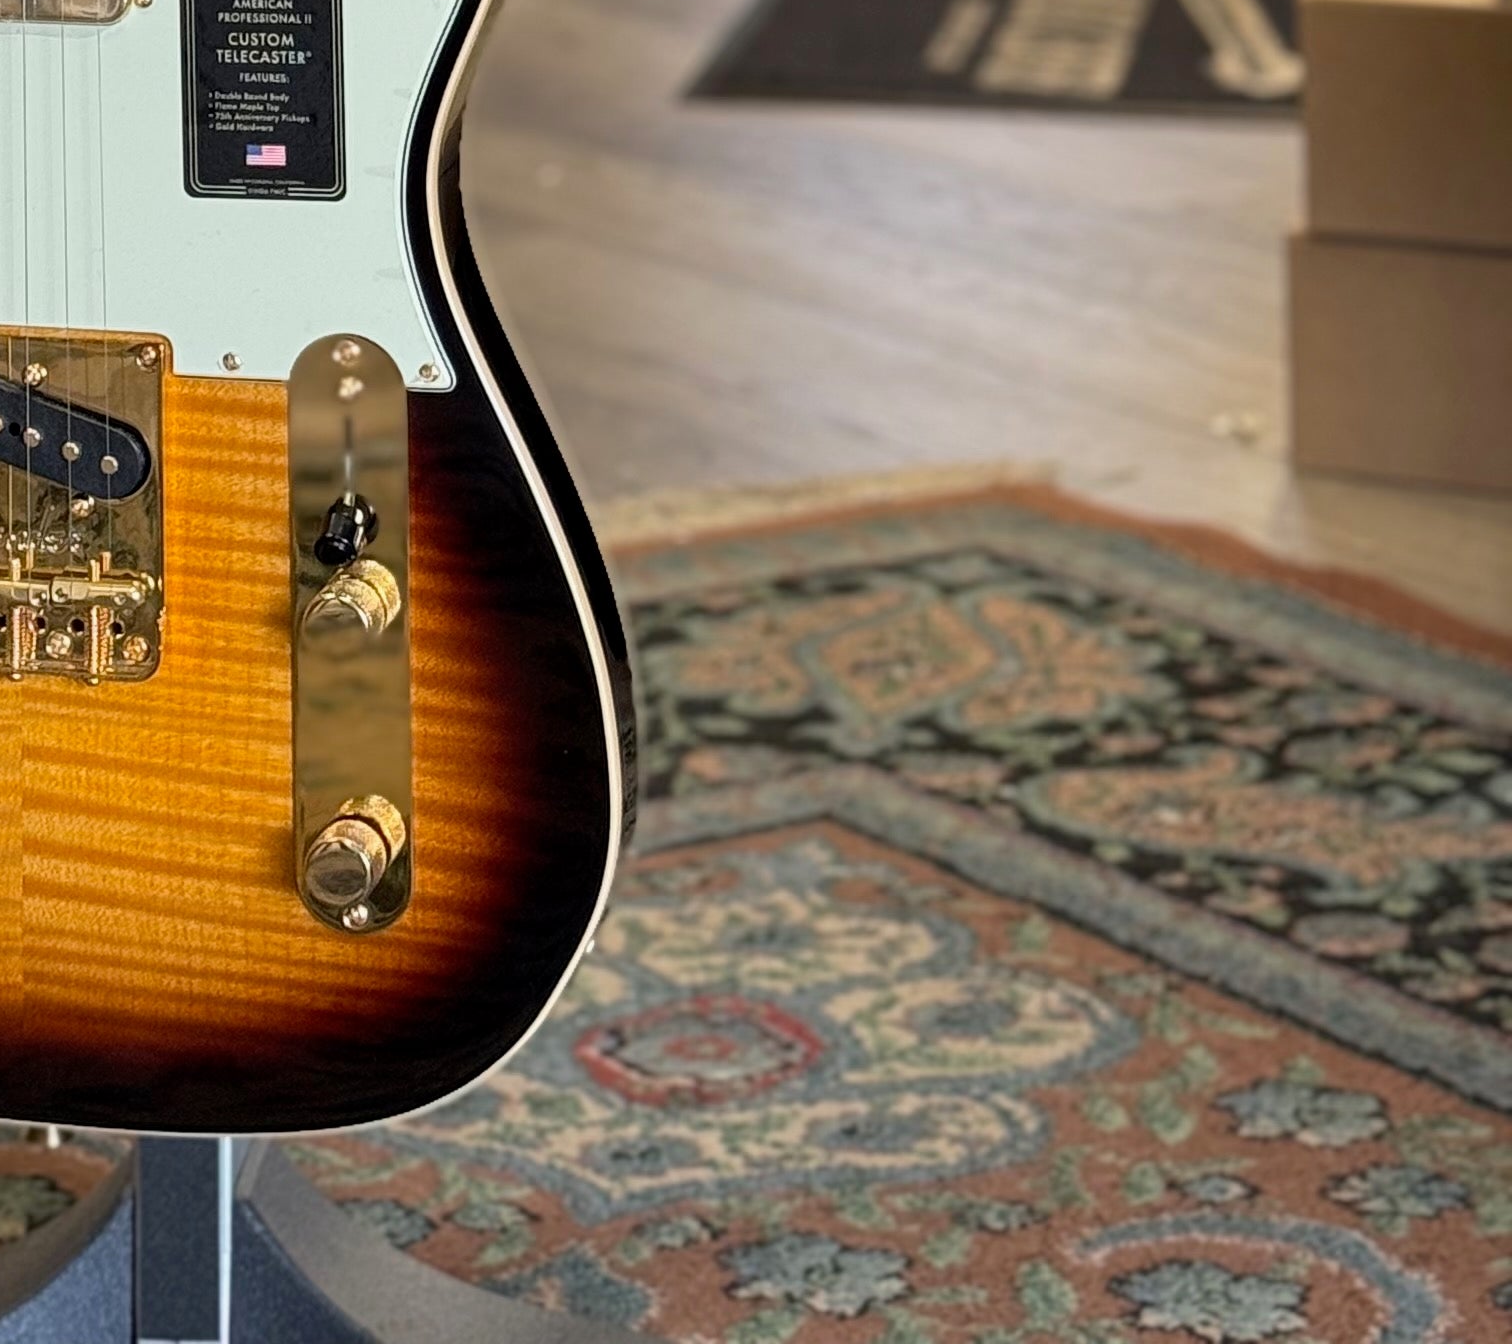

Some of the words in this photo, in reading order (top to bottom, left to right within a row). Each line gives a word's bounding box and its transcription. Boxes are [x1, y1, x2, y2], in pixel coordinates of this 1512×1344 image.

[217, 12, 302, 25] PROFESSIONAL
[304, 13, 313, 25] II
[227, 32, 295, 48] CUSTOM
